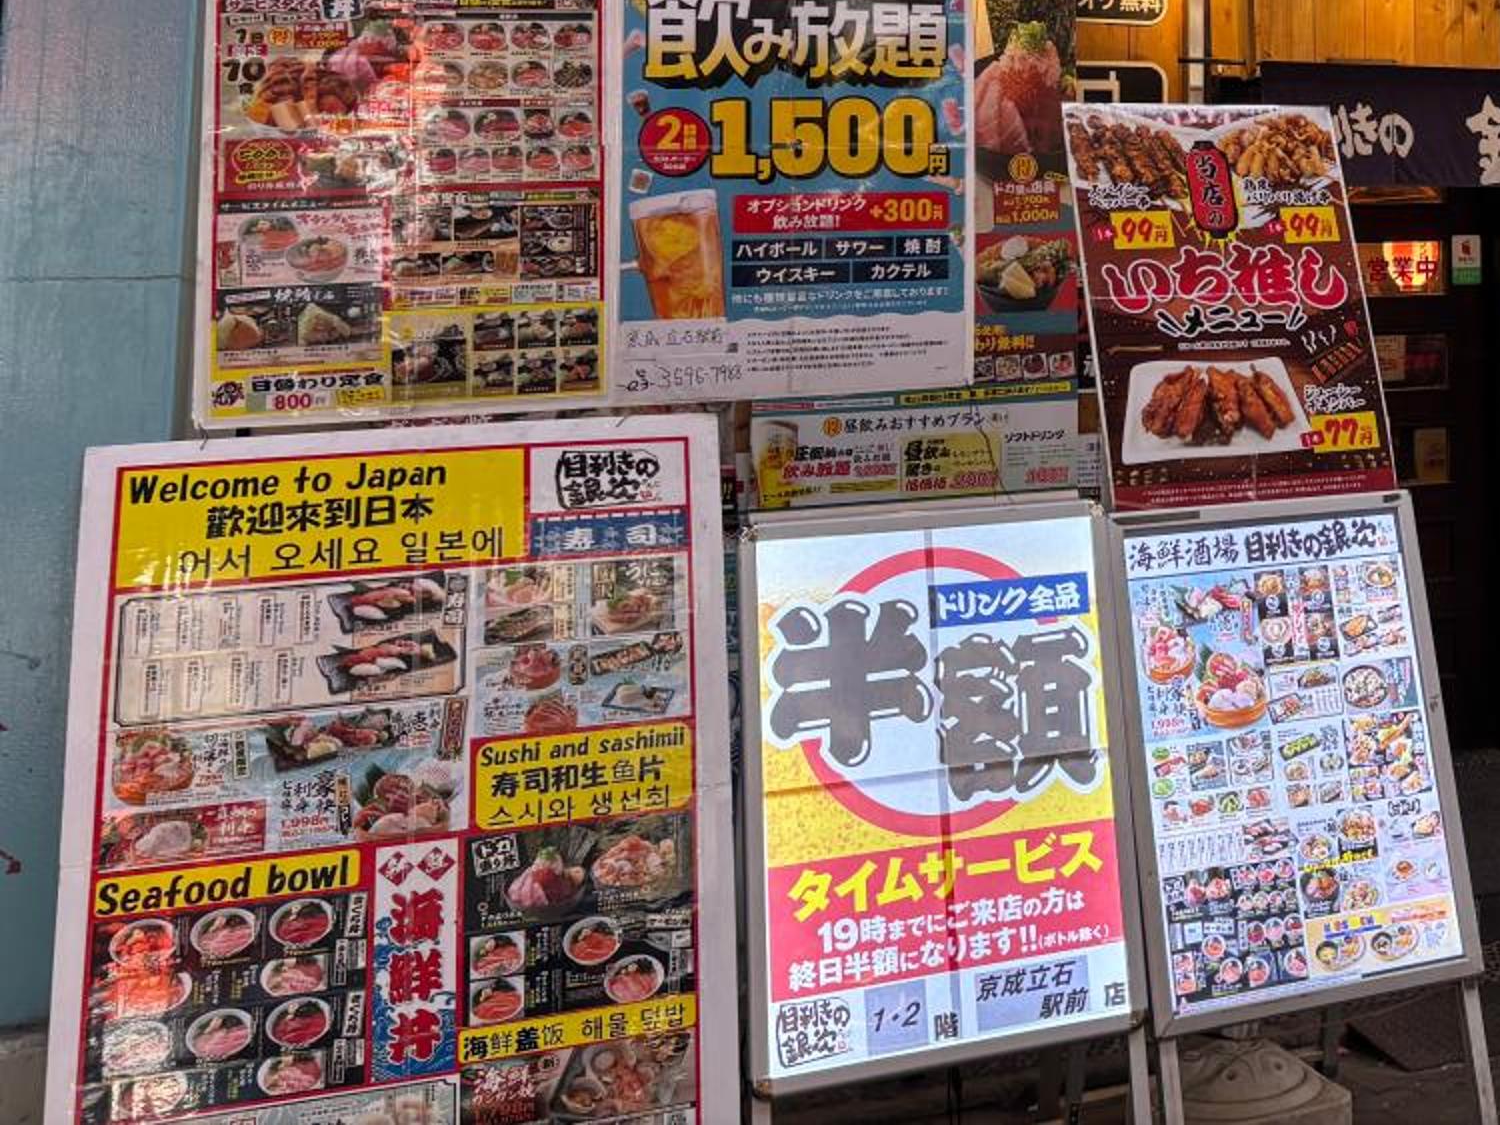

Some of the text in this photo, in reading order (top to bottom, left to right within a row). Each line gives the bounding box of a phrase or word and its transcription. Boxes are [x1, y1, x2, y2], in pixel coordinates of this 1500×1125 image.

[1195, 153, 1226, 225] 当店の
[737, 241, 818, 258] ハイボール
[835, 241, 885, 255] サワー
[756, 263, 932, 283] ウイスキー カクテル
[1102, 242, 1348, 313] いち推し
[1184, 305, 1287, 336] メニュー
[130, 463, 447, 505] Welcome to Japan
[205, 493, 434, 540] 歡迎來到日本
[179, 525, 504, 579] 어서 오세요 일본에
[1129, 518, 1378, 572] 海鮮酒場 目利きの銀次
[937, 580, 1082, 620] ドリンク全品
[769, 597, 1099, 803] 半額
[480, 740, 541, 767] Sushi
[549, 735, 589, 759] and
[491, 755, 665, 798] 寿司和生鱼片
[487, 795, 576, 827] 스시와
[96, 855, 349, 915] Seafood bowl
[788, 830, 1104, 923] タイムサービス
[817, 886, 1086, 955] 19時までにご来店の方は
[976, 960, 1076, 1003] 京成立石
[1105, 984, 1126, 1007] 店
[1039, 988, 1088, 1021] 駅前
[581, 1012, 630, 1040] 해물
[934, 1013, 960, 1041] 階
